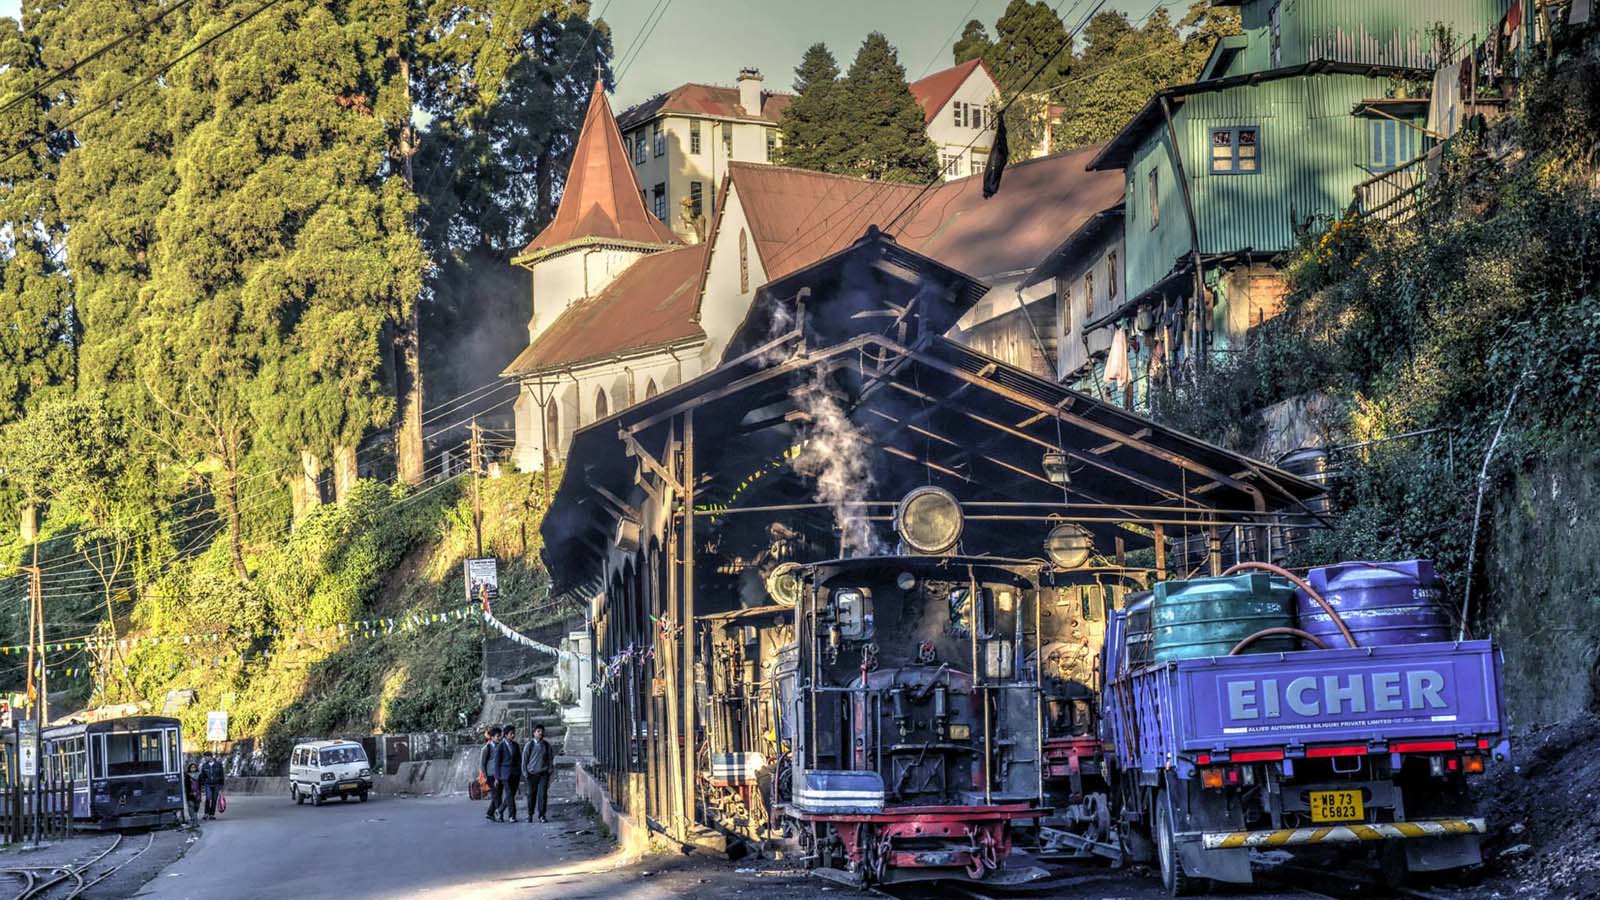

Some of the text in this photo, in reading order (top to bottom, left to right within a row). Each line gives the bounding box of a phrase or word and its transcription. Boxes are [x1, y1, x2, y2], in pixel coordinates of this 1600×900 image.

[1227, 670, 1448, 720] EICHER
[1321, 793, 1352, 806] WB 73
[1321, 806, 1356, 818] C5823
